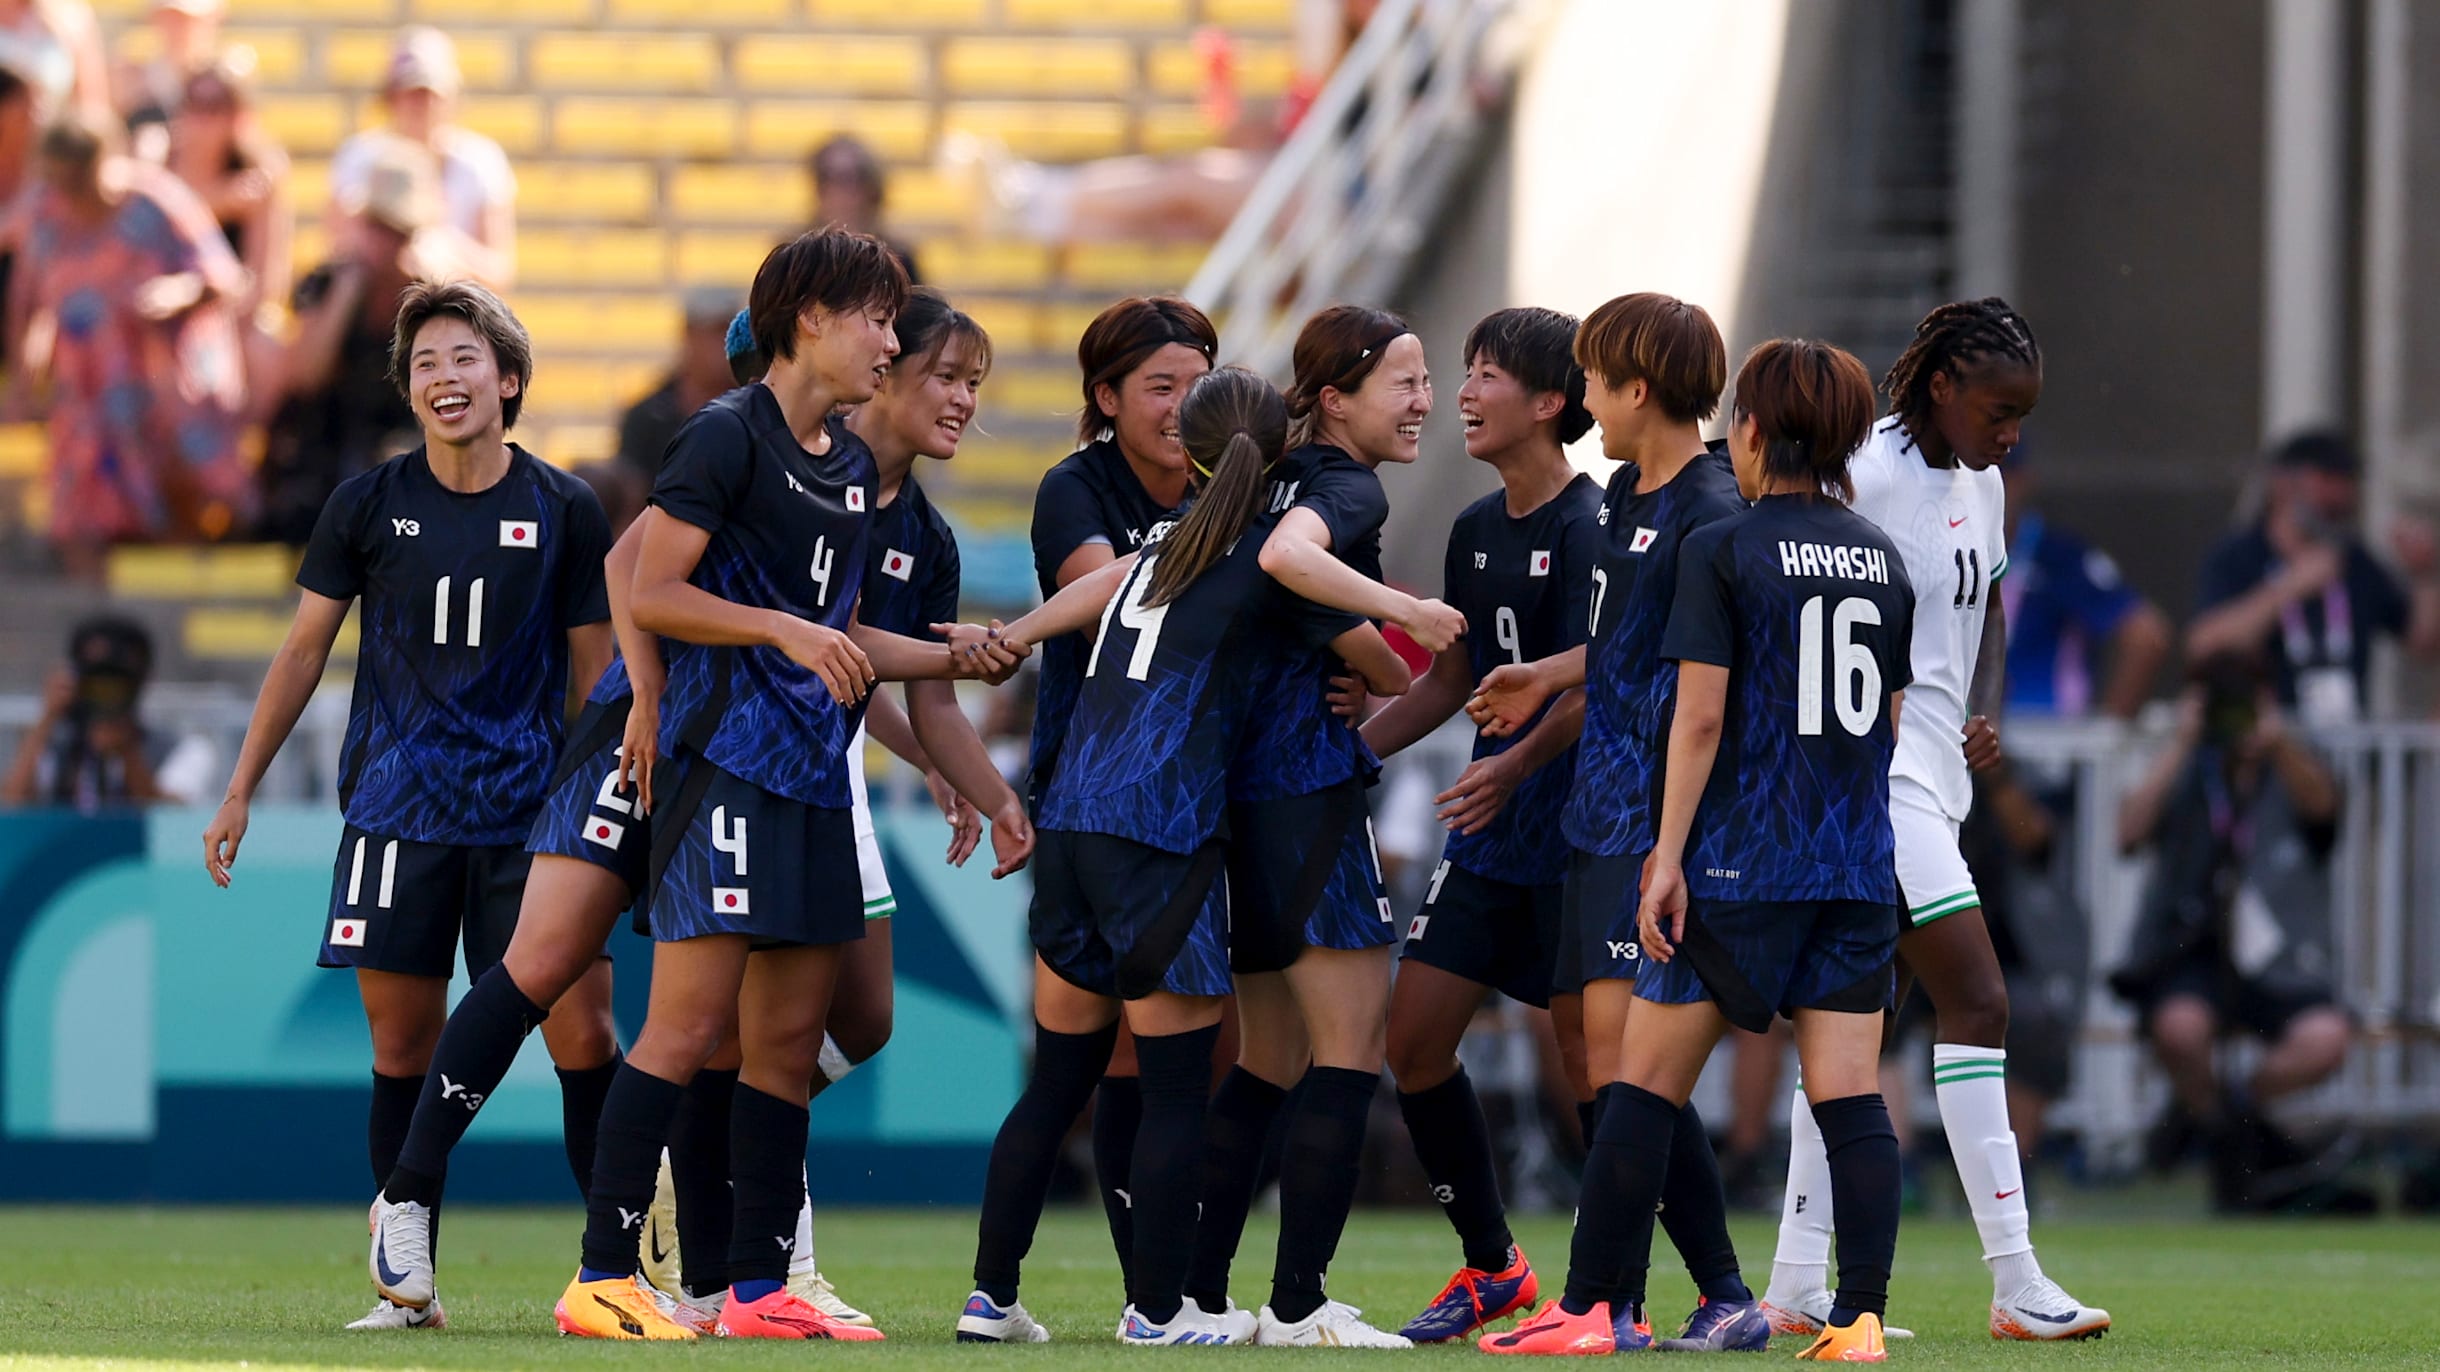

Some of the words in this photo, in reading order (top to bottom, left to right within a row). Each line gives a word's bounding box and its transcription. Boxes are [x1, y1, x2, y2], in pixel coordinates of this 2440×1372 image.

[391, 518, 421, 537] Y-3
[810, 535, 835, 607] 4
[1474, 551, 1488, 570] Y-3
[1778, 540, 1889, 585] HAYASHI
[1953, 548, 1980, 610] 11
[433, 575, 485, 648] 11
[1495, 606, 1523, 665] 9
[1798, 595, 1882, 737] 16
[711, 804, 748, 876] 4
[346, 836, 399, 909] 11
[1606, 940, 1639, 960] Y-3
[440, 1073, 484, 1111] Y-3
